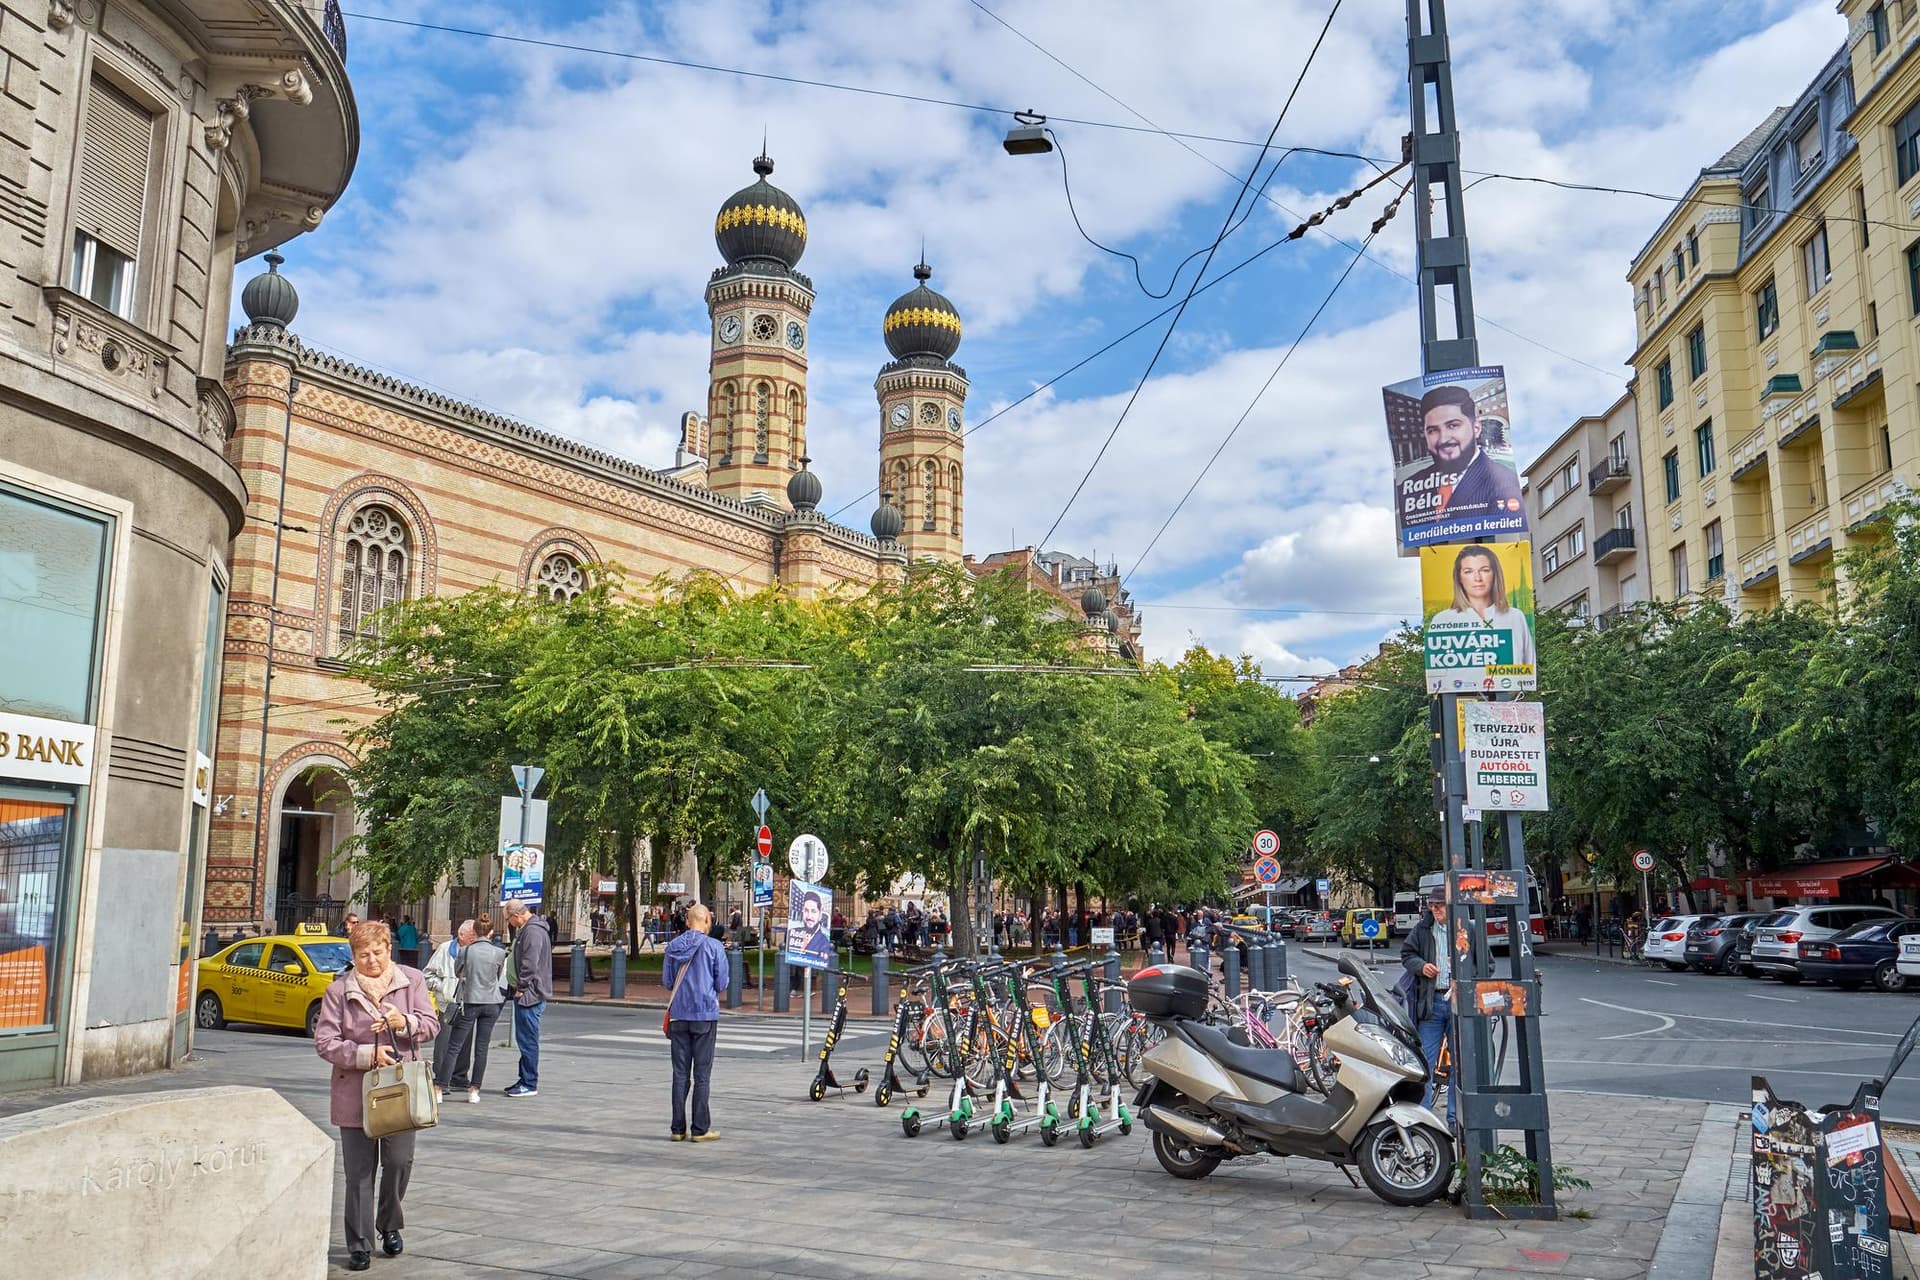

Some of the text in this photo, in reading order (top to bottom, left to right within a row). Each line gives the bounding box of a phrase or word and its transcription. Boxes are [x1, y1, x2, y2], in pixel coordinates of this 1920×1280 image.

[1402, 472, 1458, 495] Radics
[1404, 492, 1443, 513] Béla
[1408, 517, 1522, 541] Lendületben a kerület!
[1430, 621, 1469, 630] OKTÓBER
[1427, 631, 1505, 650] UJVÁRI-
[1429, 648, 1498, 668] KÖVÉR
[1473, 723, 1536, 734] TERVEZZÜK
[1490, 736, 1519, 747] ÚJRA
[15, 734, 84, 767] BANK
[1470, 749, 1540, 760] BUDAPESTET
[1480, 760, 1532, 771] AUTÓRÓL
[1479, 774, 1535, 785] EMBERRE!
[1260, 838, 1273, 849] 30
[1639, 856, 1651, 865] 30
